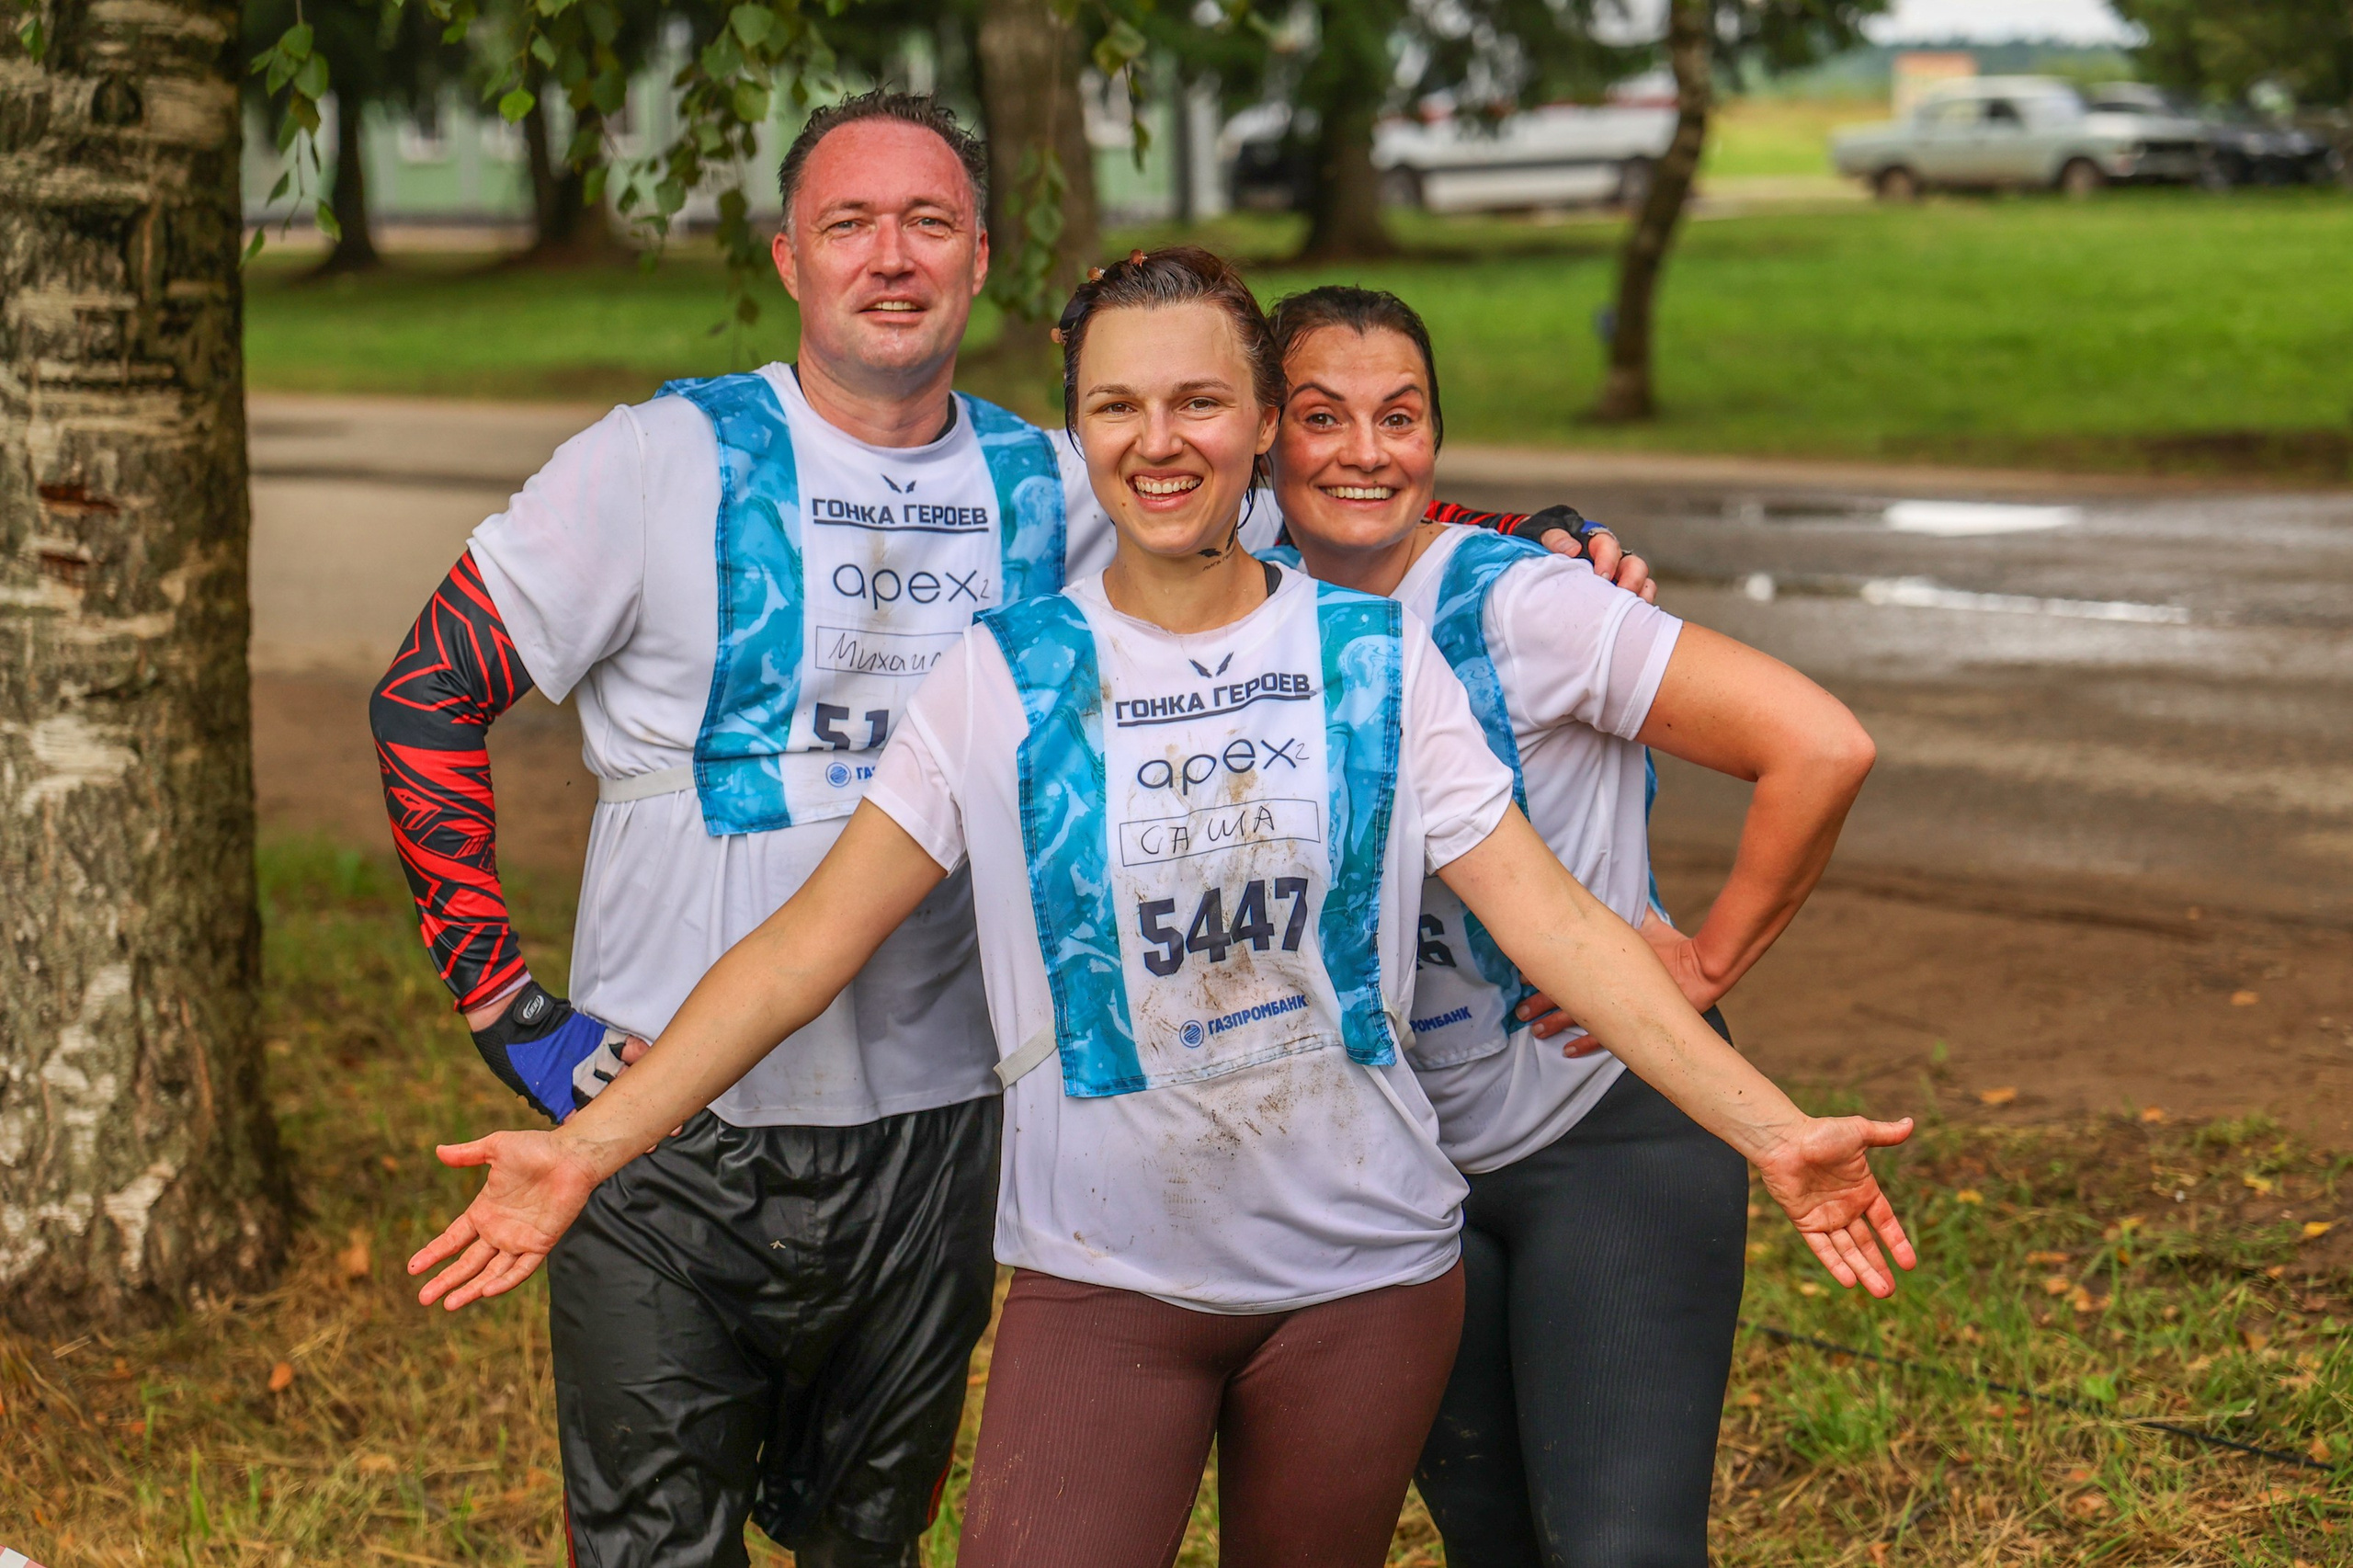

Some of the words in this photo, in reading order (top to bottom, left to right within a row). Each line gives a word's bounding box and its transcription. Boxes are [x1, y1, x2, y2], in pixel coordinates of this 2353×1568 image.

[812, 498, 895, 525] ГОНКА
[903, 504, 989, 526] ГЕРОЕВ
[1115, 691, 1206, 720] ГОНКА
[1212, 672, 1311, 708] ГЕРОЕВ
[1140, 805, 1276, 855] САША
[1138, 876, 1309, 978] 5447
[1207, 994, 1309, 1036] ГАЗПРОМБАНК
[1409, 1006, 1472, 1033] РОМБАНК
